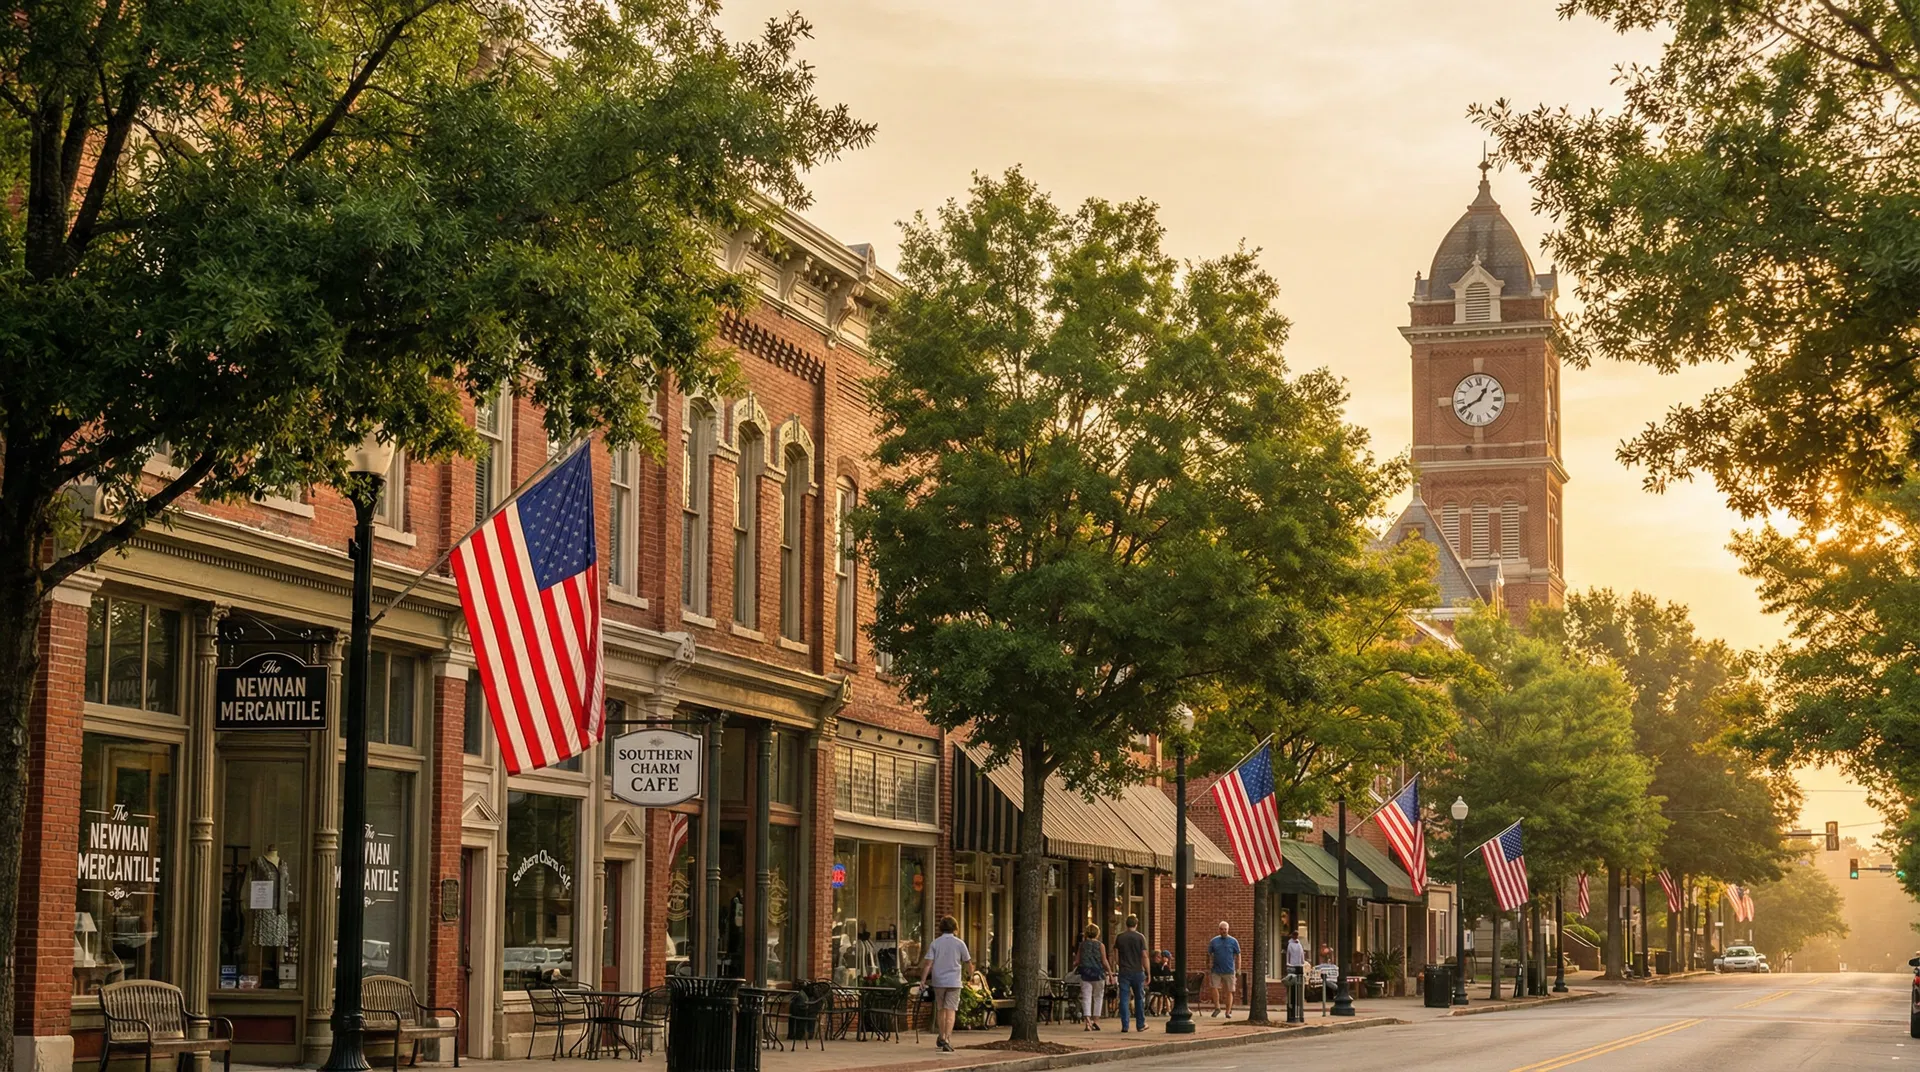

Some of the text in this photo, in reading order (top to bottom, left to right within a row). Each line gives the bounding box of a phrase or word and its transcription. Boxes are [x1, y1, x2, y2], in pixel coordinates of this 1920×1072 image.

[259, 660, 281, 673] The
[236, 677, 306, 697] NEWNAN
[221, 700, 321, 721] MERCANTILE
[619, 749, 693, 760] SOUTHERN
[631, 763, 680, 774] CHARM
[631, 777, 679, 792] CAFE
[111, 804, 128, 821] The
[90, 822, 149, 852] NEWNAN
[77, 852, 161, 882] MERCANTILE
[334, 865, 399, 892] MANTILE
